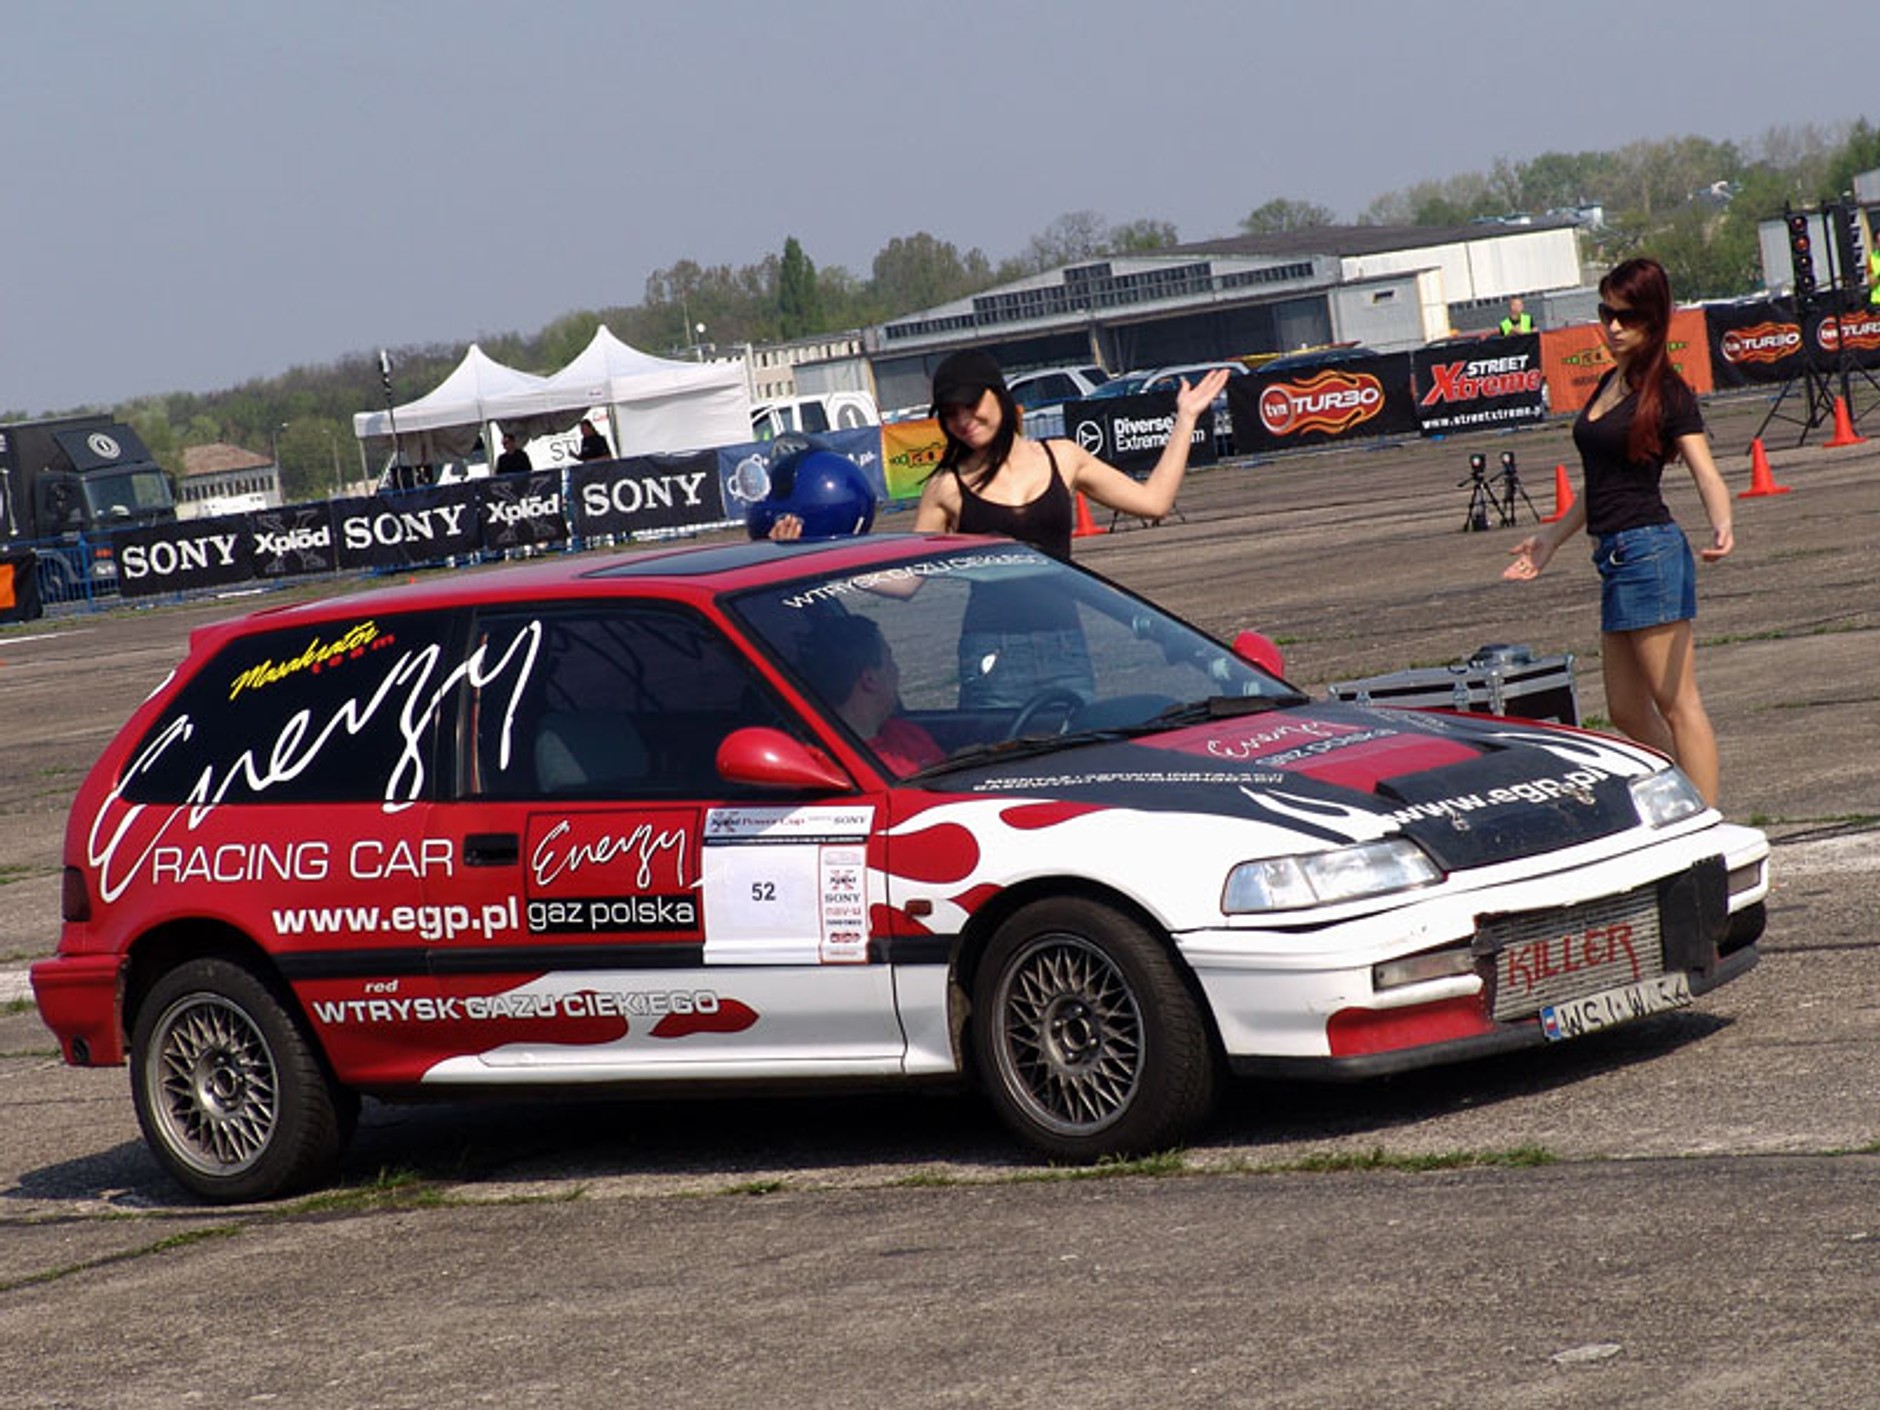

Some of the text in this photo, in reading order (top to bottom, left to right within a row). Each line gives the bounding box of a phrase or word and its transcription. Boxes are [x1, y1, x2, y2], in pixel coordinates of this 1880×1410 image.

[1467, 355, 1529, 377] STREET
[1114, 416, 1174, 434] Diverse
[1265, 402, 1288, 418] tvn
[582, 473, 706, 516] SONY
[343, 504, 466, 549] SONY
[122, 534, 238, 578] SONY
[87, 620, 542, 903] Energy
[833, 815, 866, 824] SONY
[153, 839, 453, 883] RACING CAR
[532, 820, 686, 889] Energy
[751, 882, 776, 901] 52
[825, 893, 861, 903] SONY
[271, 896, 519, 939] www.egp.pl
[527, 896, 695, 930] gaz polska
[1507, 922, 1641, 997] KILLER
[365, 979, 398, 993] red
[313, 989, 720, 1024] WTRYSK GAZU CIEKIEGO
